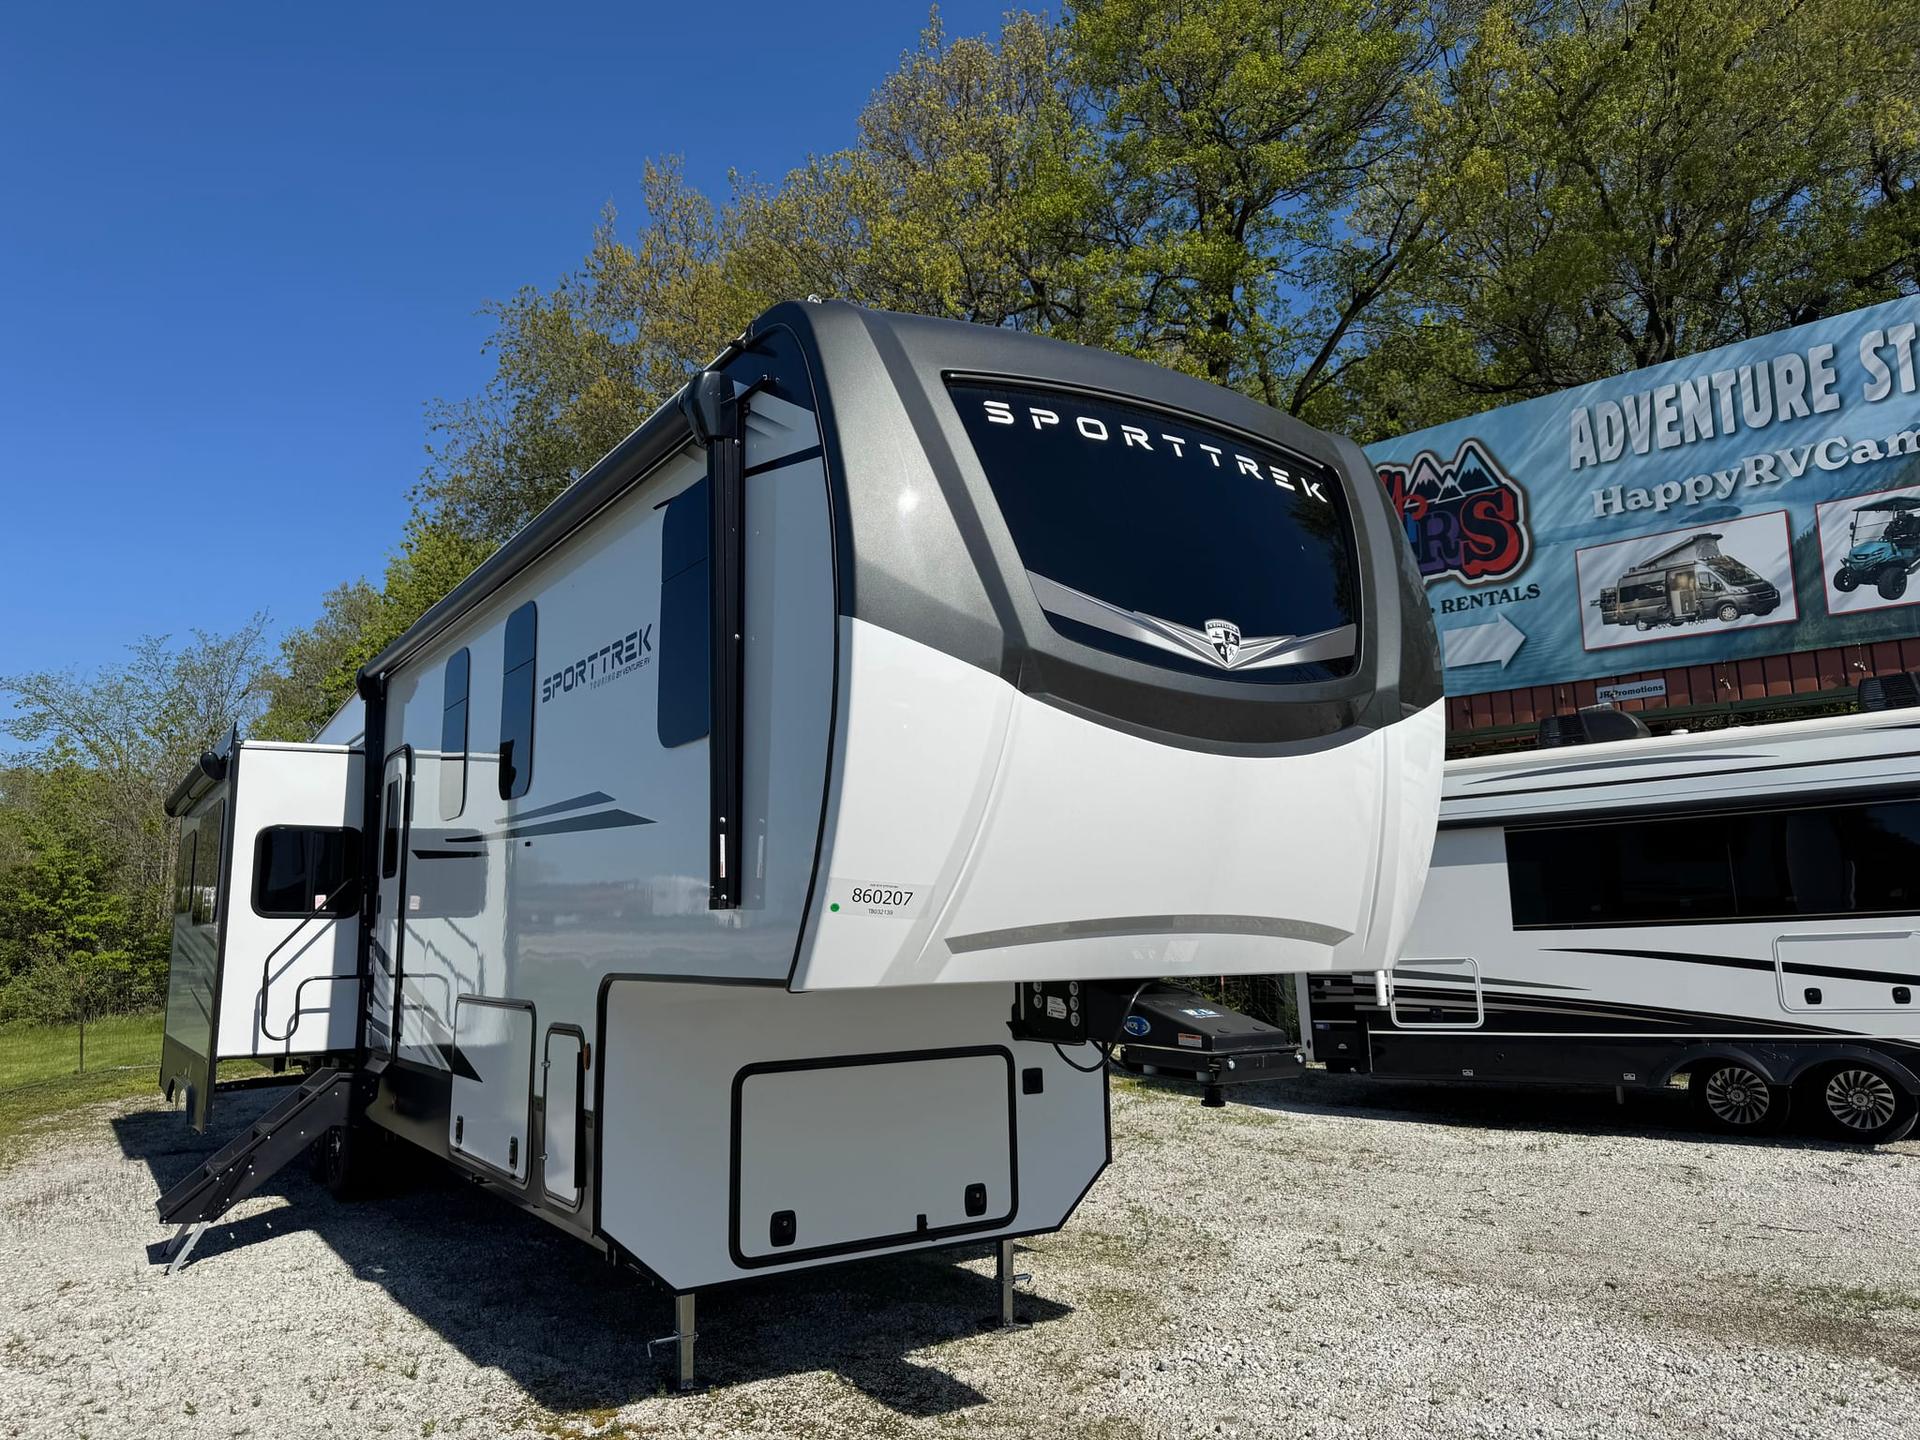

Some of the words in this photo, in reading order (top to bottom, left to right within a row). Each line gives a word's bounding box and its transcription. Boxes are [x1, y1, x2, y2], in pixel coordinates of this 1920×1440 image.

[1570, 344, 1839, 470] ADVENTURE
[1860, 322, 1916, 402] ST
[983, 400, 1328, 503] SPORTTREK
[1441, 584, 1541, 614] RENTALS
[543, 624, 652, 703] SPORTTREK
[852, 888, 913, 906] 860207
